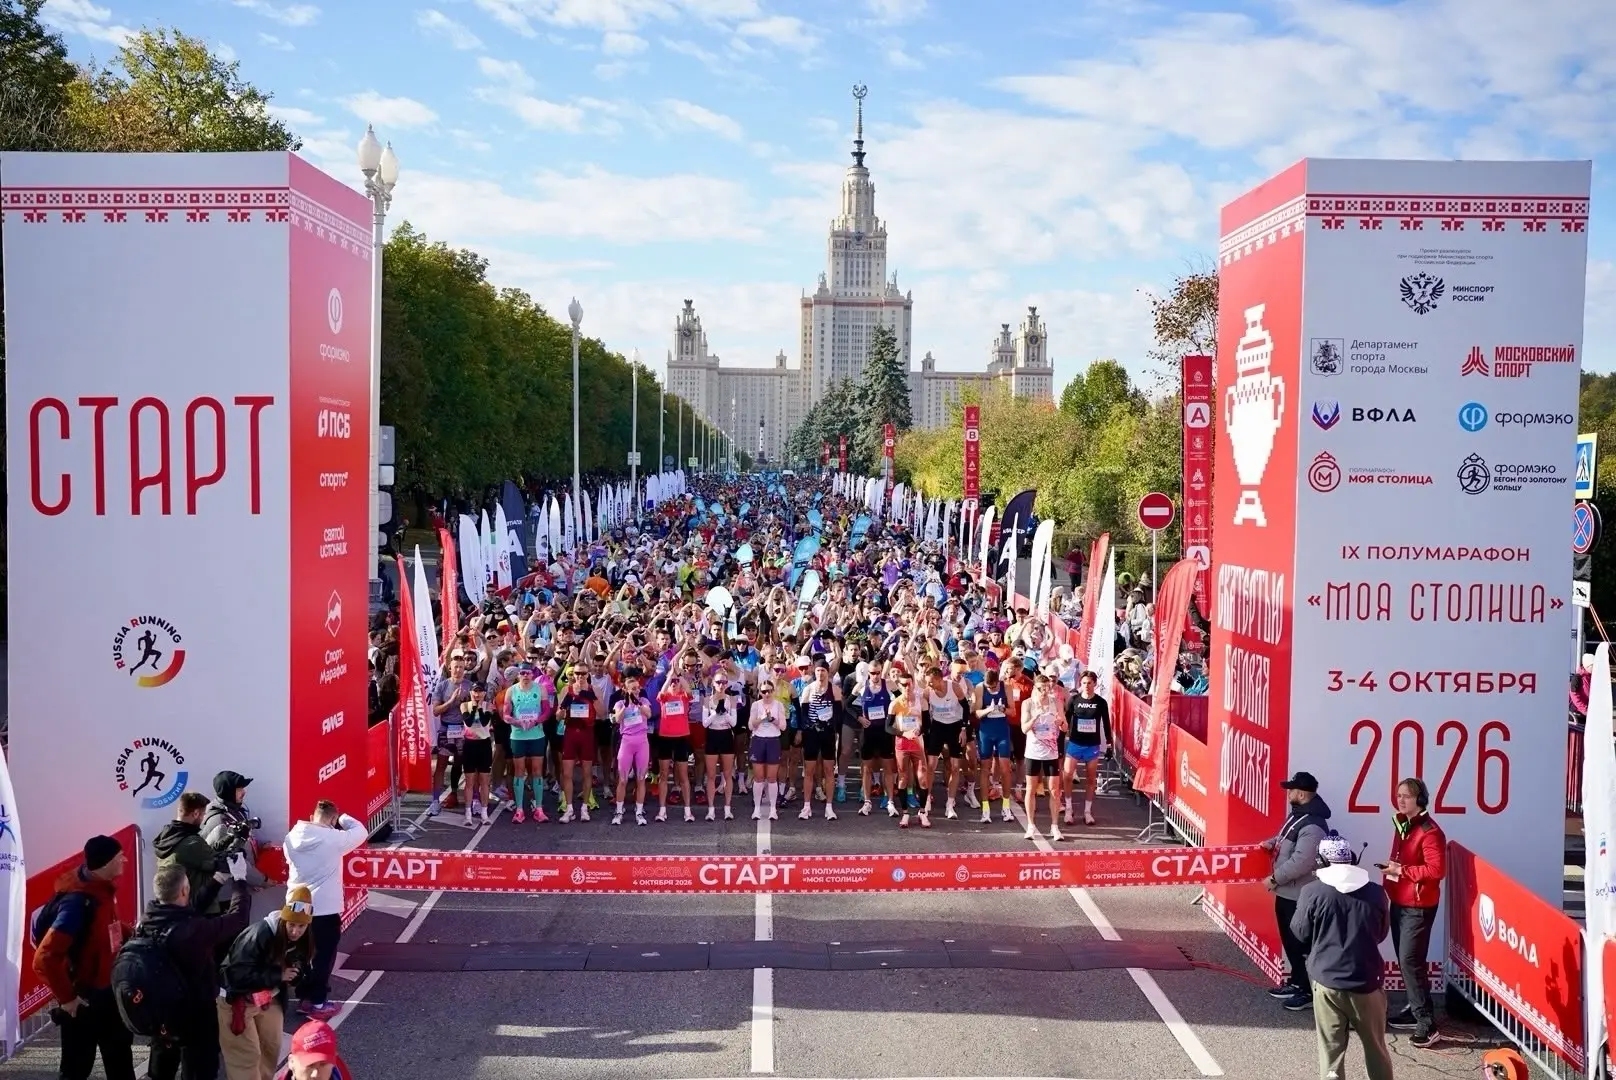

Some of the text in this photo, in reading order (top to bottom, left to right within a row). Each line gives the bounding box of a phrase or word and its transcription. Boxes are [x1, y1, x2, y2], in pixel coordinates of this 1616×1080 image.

[1350, 339, 1418, 351] Департамент
[1494, 343, 1575, 363] МОСКОВСКИЙ
[1350, 352, 1386, 363] спорта
[1350, 364, 1428, 375] города Москвы
[1494, 362, 1532, 378] СПОРТ
[1352, 407, 1417, 423] ВФЛА
[1494, 410, 1574, 428] фармэко
[329, 412, 351, 439] ПСБ
[28, 395, 275, 516] СТАРТ
[1348, 475, 1433, 485] МОЯ СТОЛИЦА
[1494, 464, 1557, 476] фармэко
[1341, 545, 1531, 562] IX ПОЛУМАРАФОН
[1217, 563, 1285, 646] СКАТЕРТЬЮ
[1307, 581, 1564, 623] «МОЯ СТОЛИЦА»
[113, 615, 182, 669] RUSSIA RUNNING
[1223, 644, 1271, 730] БЕГОВАЯ
[1327, 670, 1538, 694] 3-4 ОКТЯБРЯ
[115, 737, 185, 791] RUSSIA RUNNING
[1219, 720, 1271, 817] ДОРОЖКА
[1347, 719, 1511, 815] 2026
[152, 782, 185, 807] СОБЫТИЯ
[347, 856, 443, 881] СТАРТ
[631, 866, 692, 878] МОСКВА
[699, 863, 796, 886] СТАРТ
[811, 867, 874, 876] ПОЛУМАРАФОН
[1033, 868, 1061, 881] ПСБ
[1084, 859, 1145, 872] МОСКВА
[1151, 853, 1247, 877] СТАРТ
[825, 875, 867, 883] СТОЛИЦА»
[1091, 872, 1126, 880] ОКТЯБРЯ
[1498, 918, 1540, 968] ВФЛА
